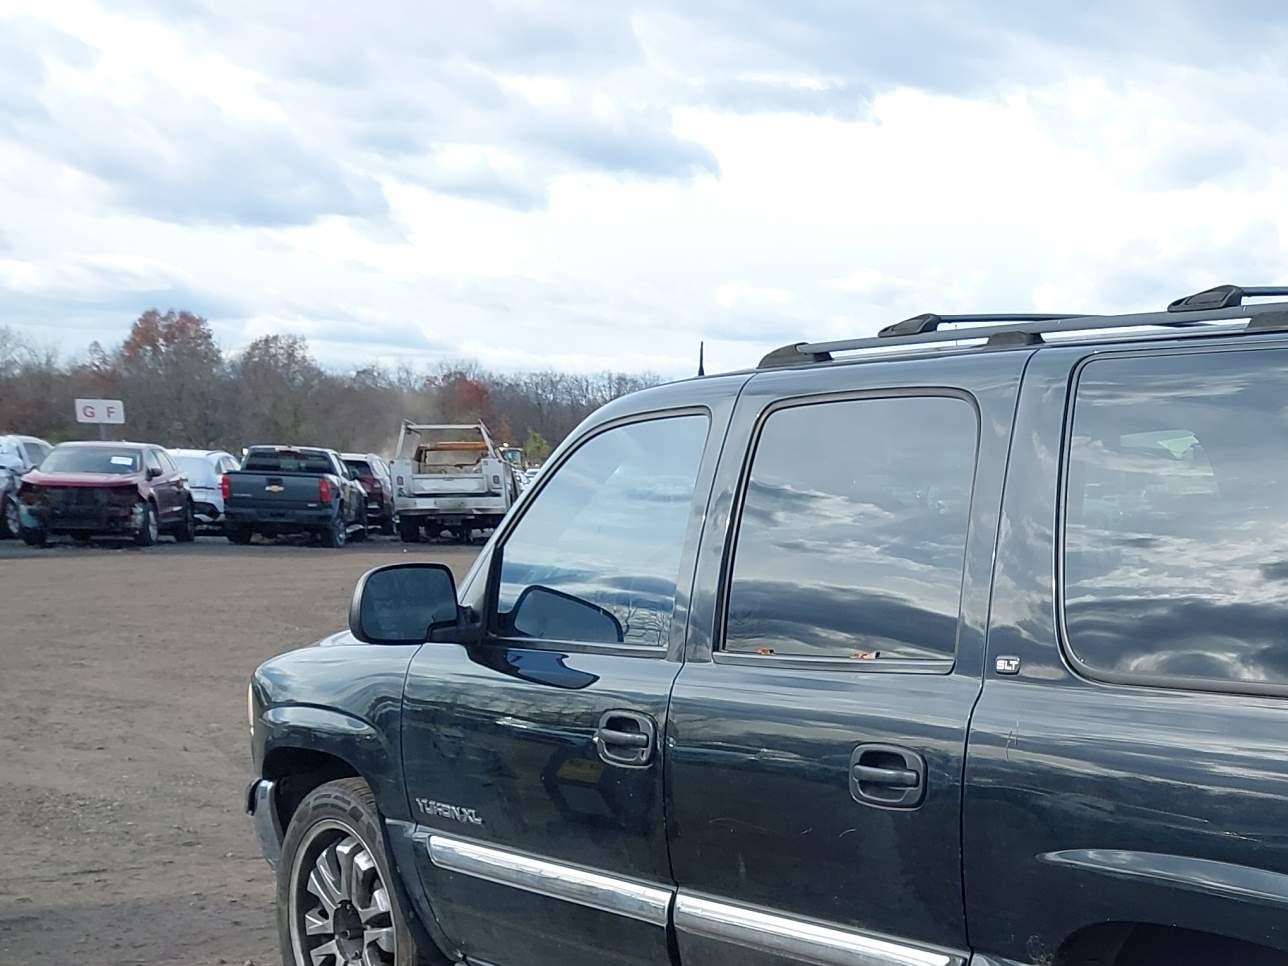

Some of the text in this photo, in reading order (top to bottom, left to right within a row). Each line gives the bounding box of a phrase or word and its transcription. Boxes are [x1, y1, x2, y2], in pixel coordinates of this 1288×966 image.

[83, 405, 116, 418] G F
[996, 660, 1019, 671] SLT
